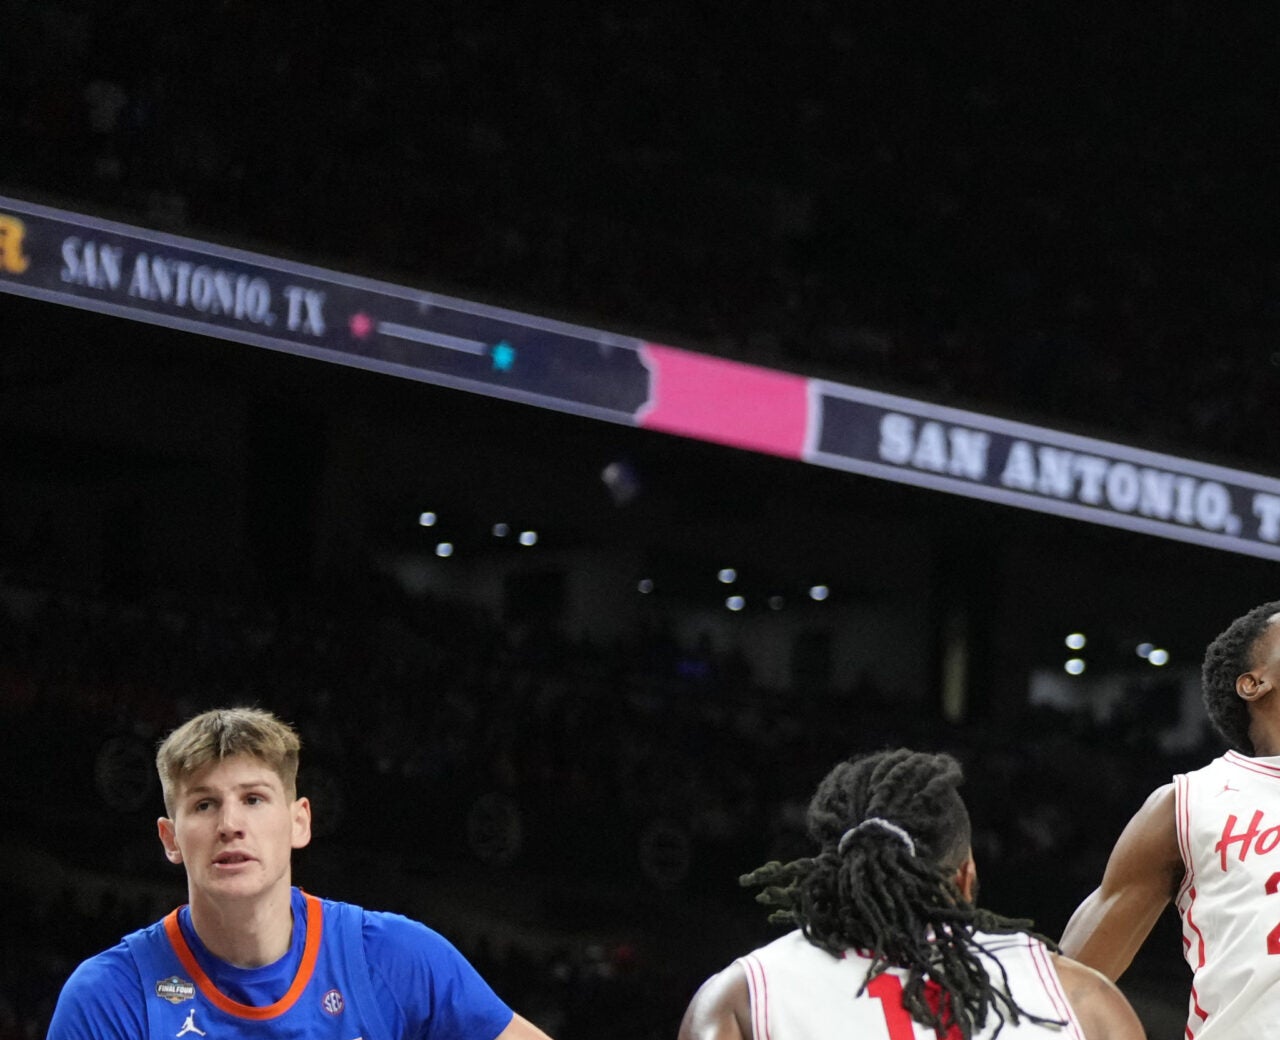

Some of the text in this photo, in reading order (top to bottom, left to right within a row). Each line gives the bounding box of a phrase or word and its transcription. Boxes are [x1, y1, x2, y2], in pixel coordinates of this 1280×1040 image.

[60, 235, 327, 337] SAN ANTONIO, TX
[879, 412, 991, 481] SAN
[1001, 440, 1242, 537] ANTONIO,
[324, 991, 343, 1012] SEC
